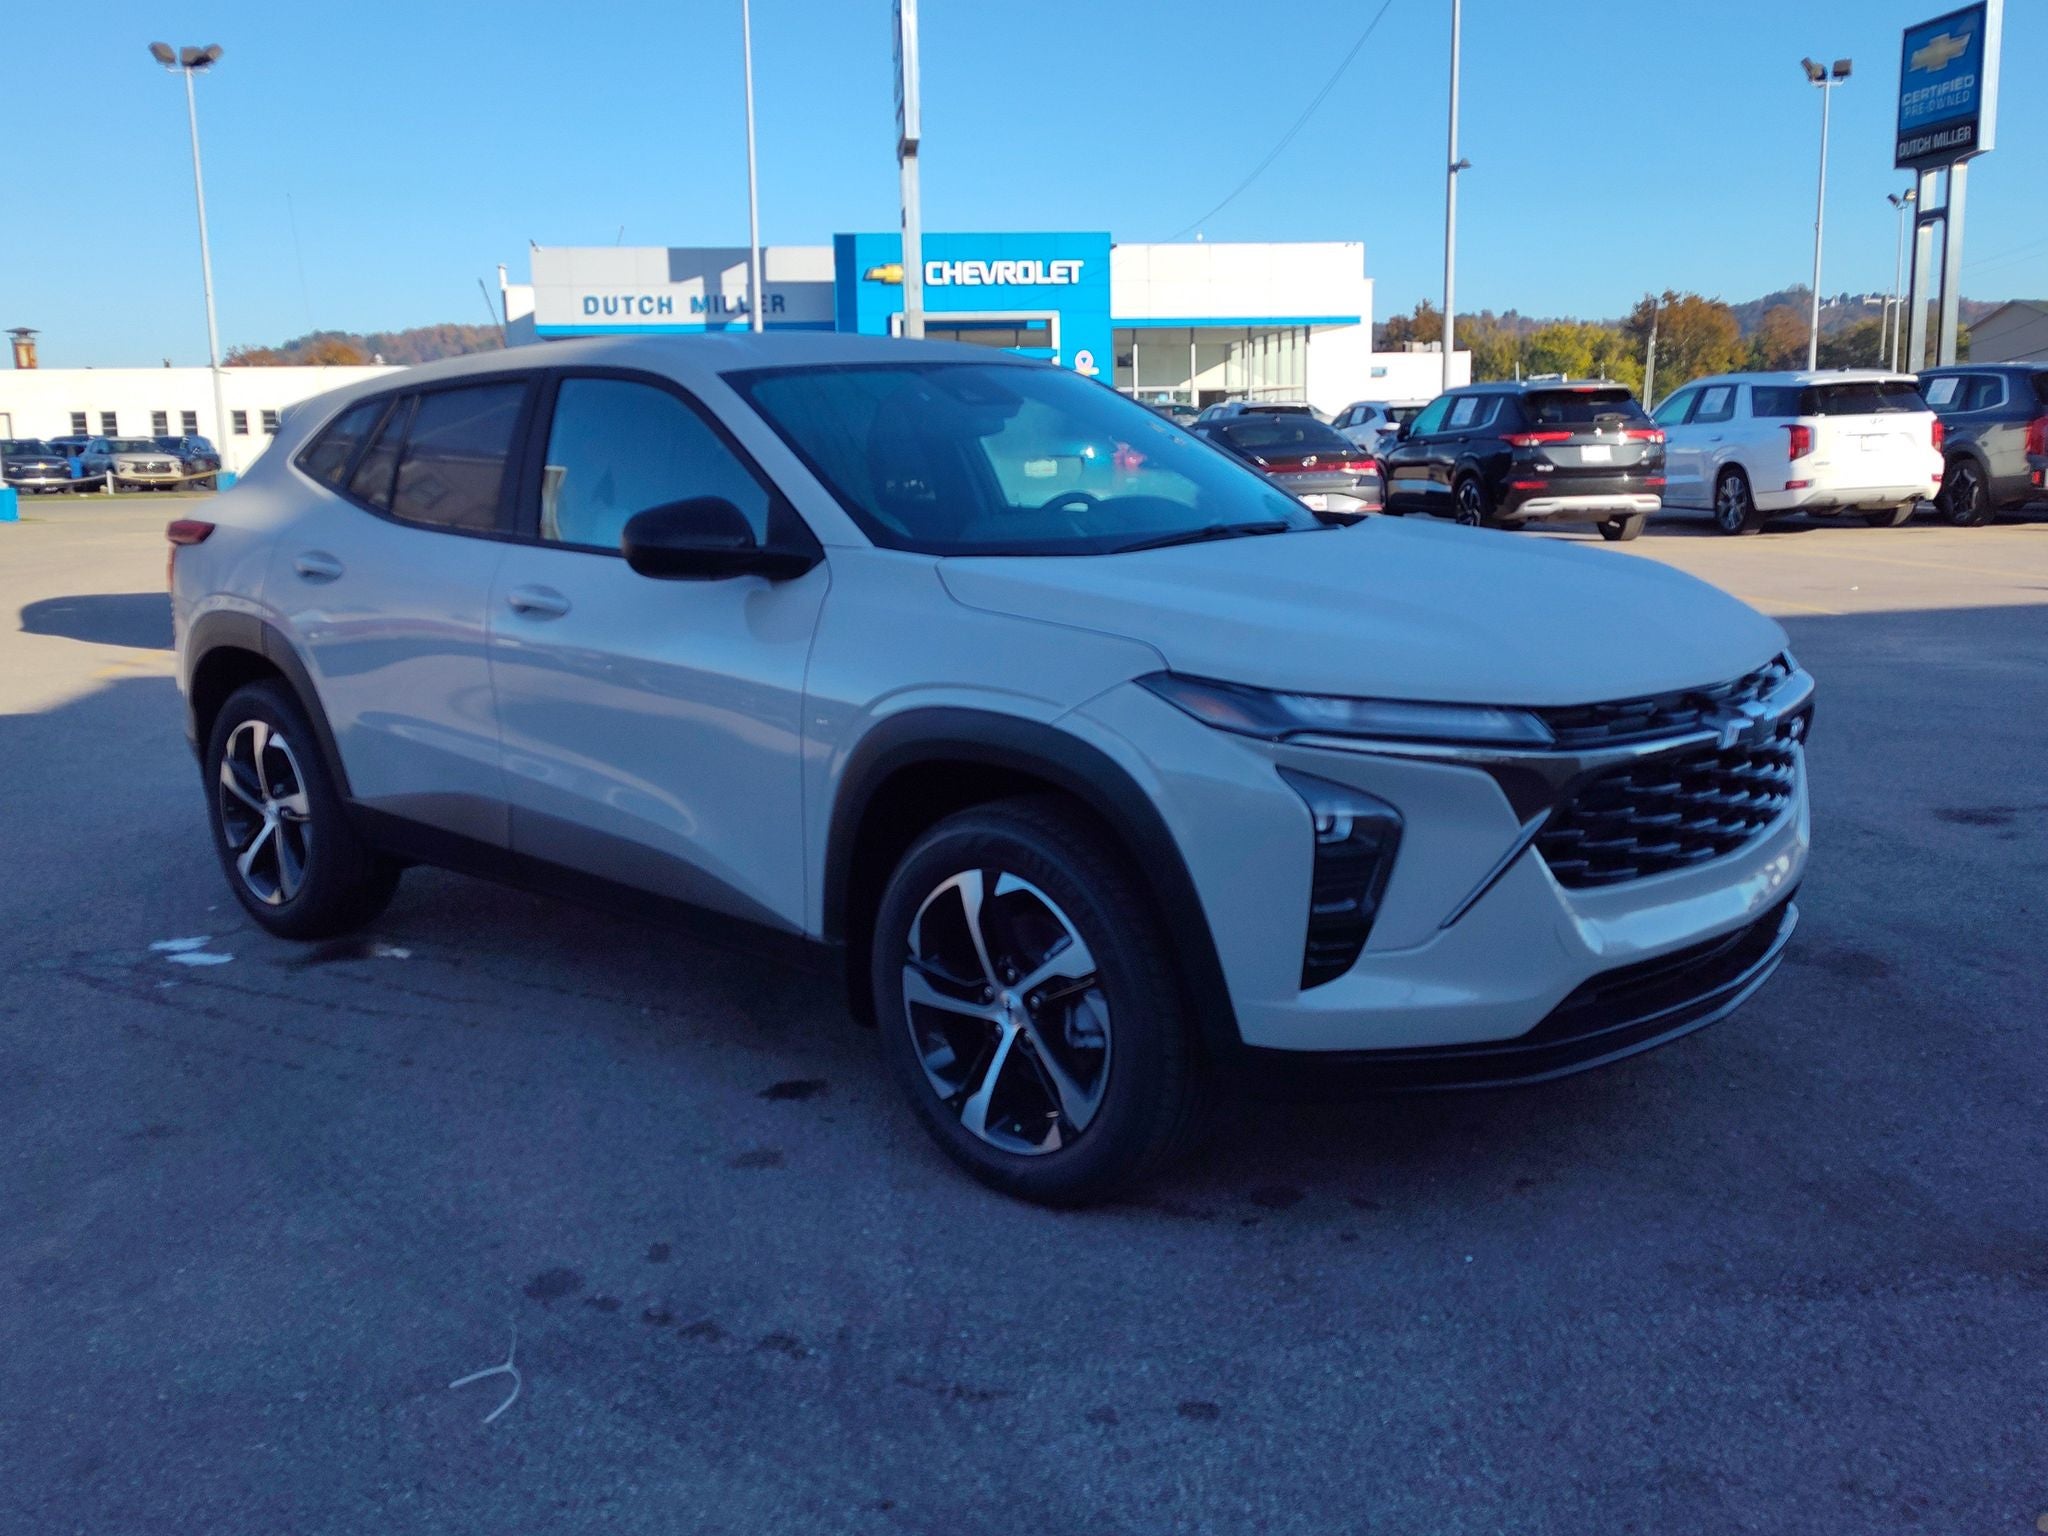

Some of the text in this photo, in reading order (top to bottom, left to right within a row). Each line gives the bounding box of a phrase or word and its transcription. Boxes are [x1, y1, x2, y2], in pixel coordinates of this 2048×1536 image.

[1902, 74, 1975, 106] CERTIFIED
[1904, 90, 1970, 118] PRE-OWNED
[1899, 126, 1971, 157] DUTCH MILLER
[925, 260, 1084, 285] CHEVROLET
[583, 295, 673, 315] DUTCH
